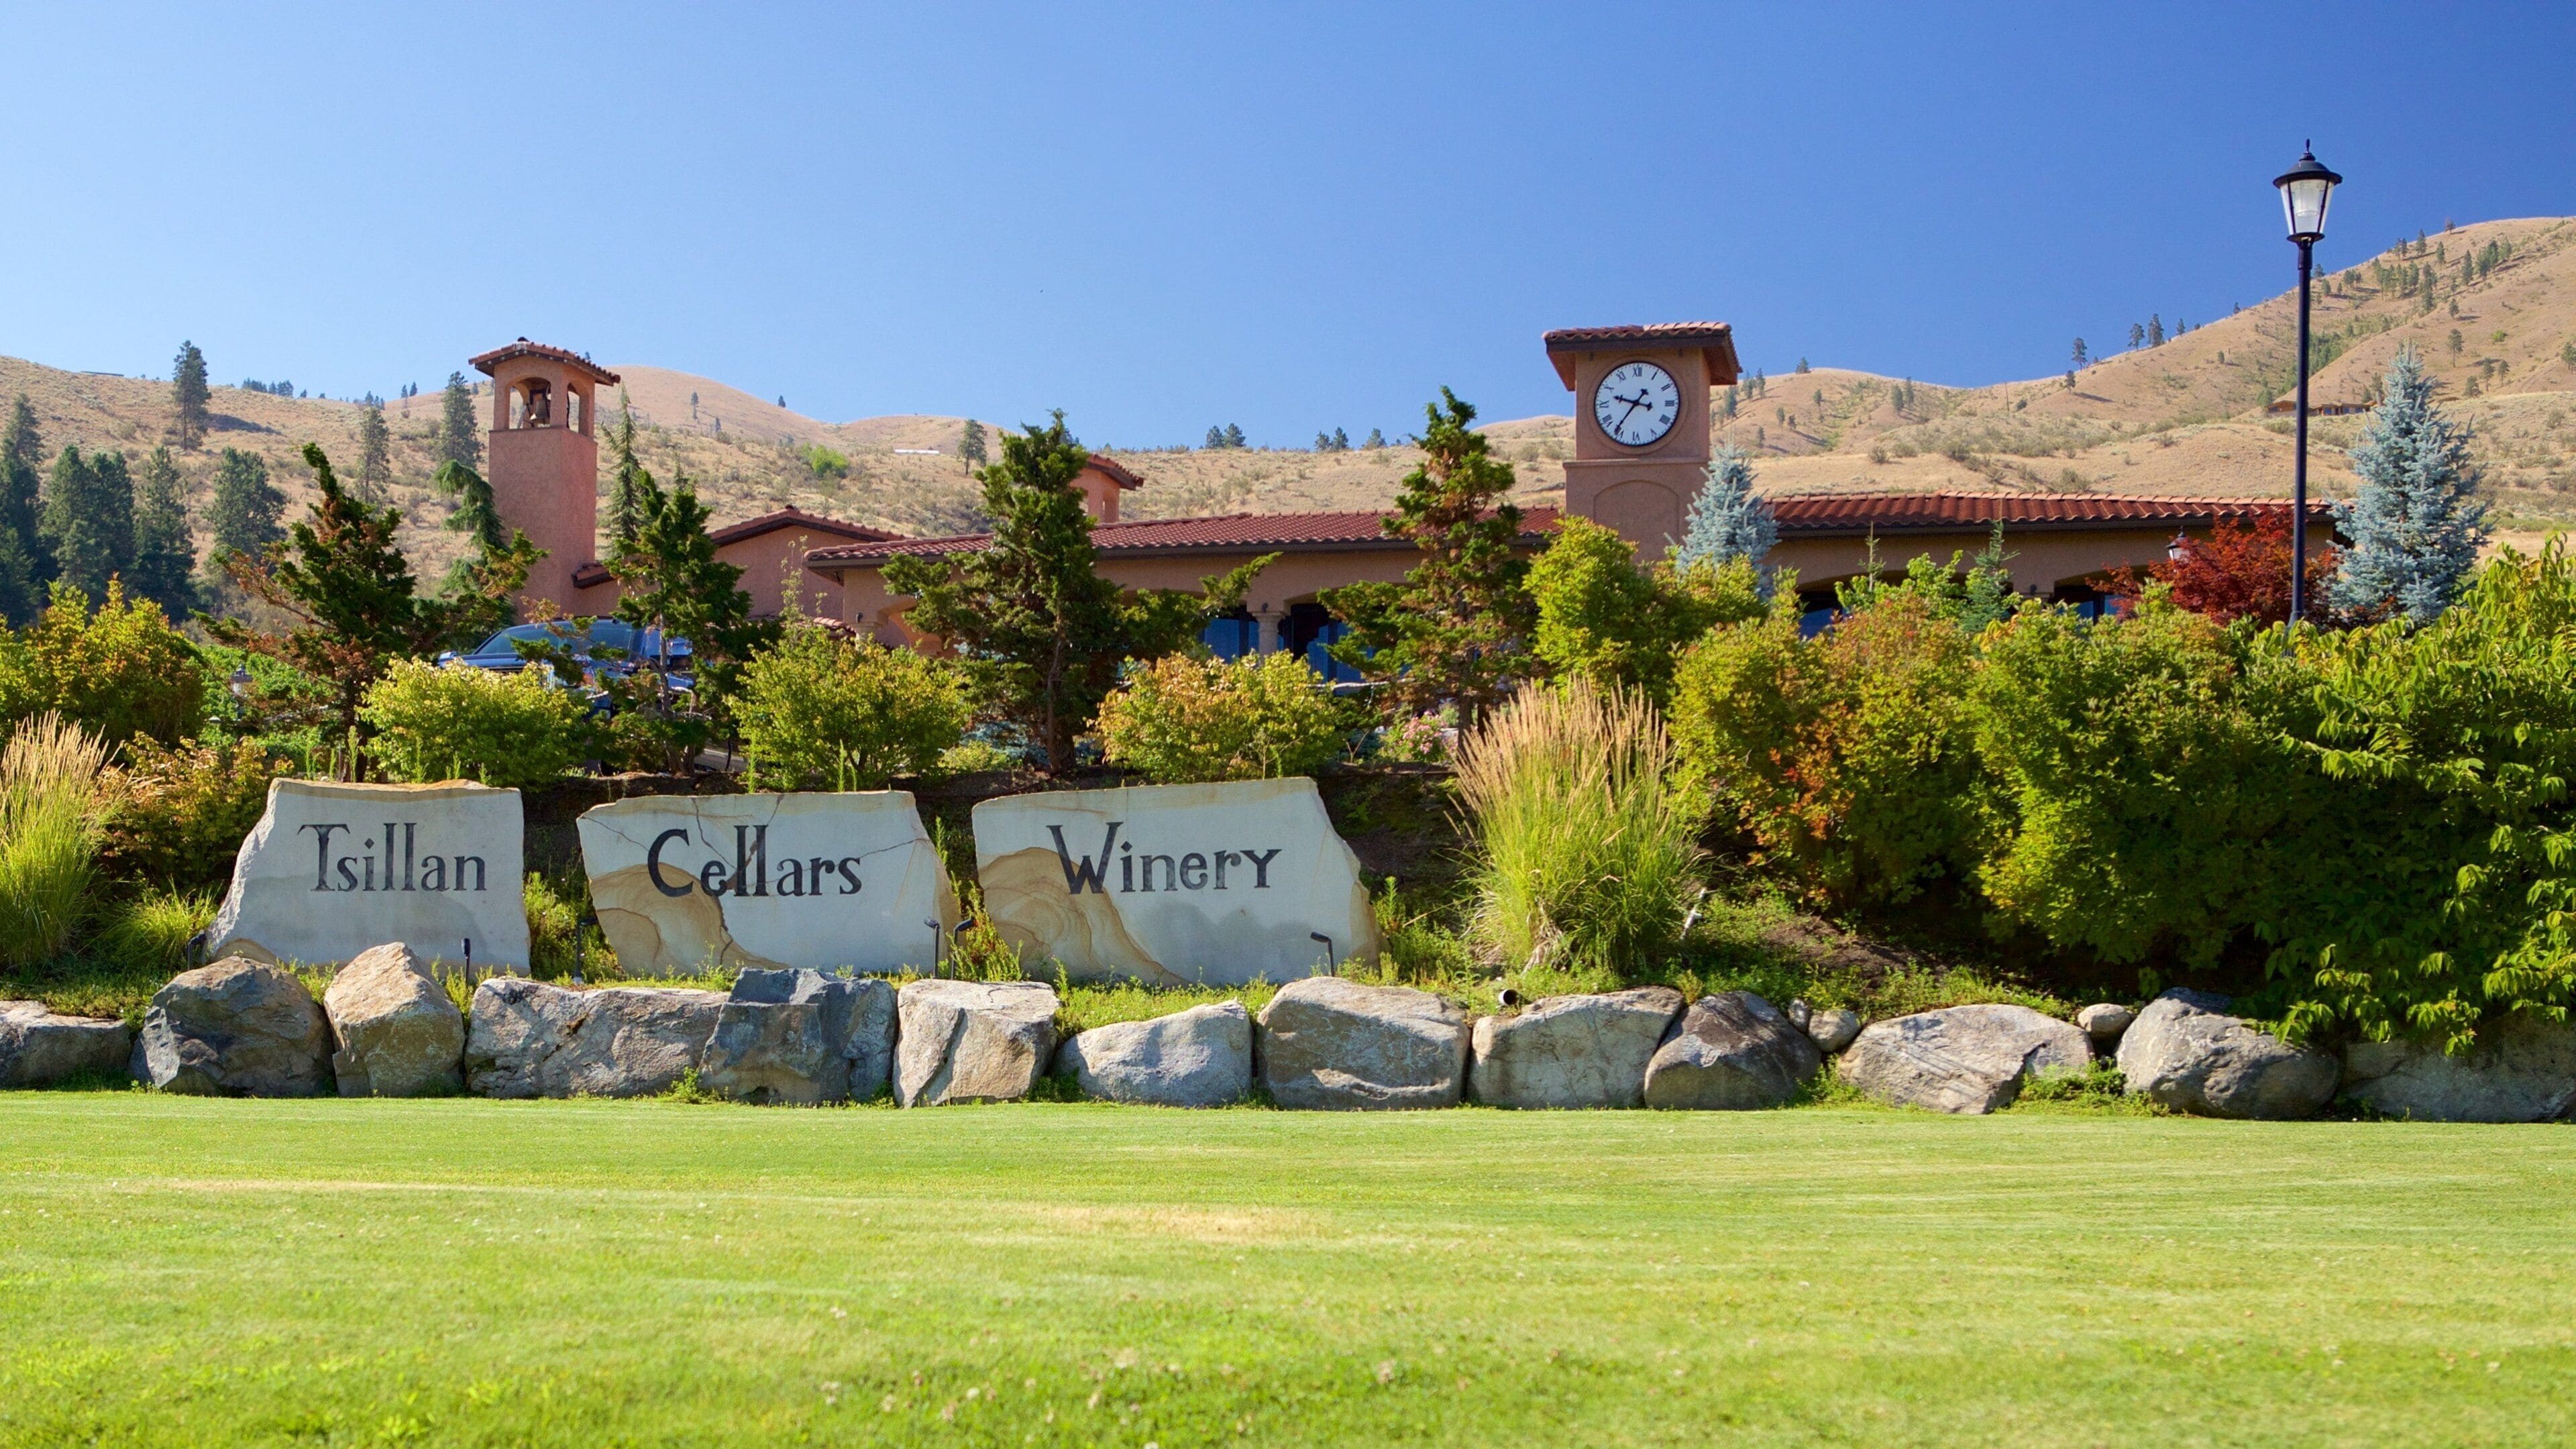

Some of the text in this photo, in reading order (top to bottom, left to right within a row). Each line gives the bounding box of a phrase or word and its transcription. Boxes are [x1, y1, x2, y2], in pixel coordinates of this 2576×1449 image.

[1632, 366, 1643, 377] XII
[297, 822, 487, 893] Tsillan
[647, 824, 863, 898] Cellars
